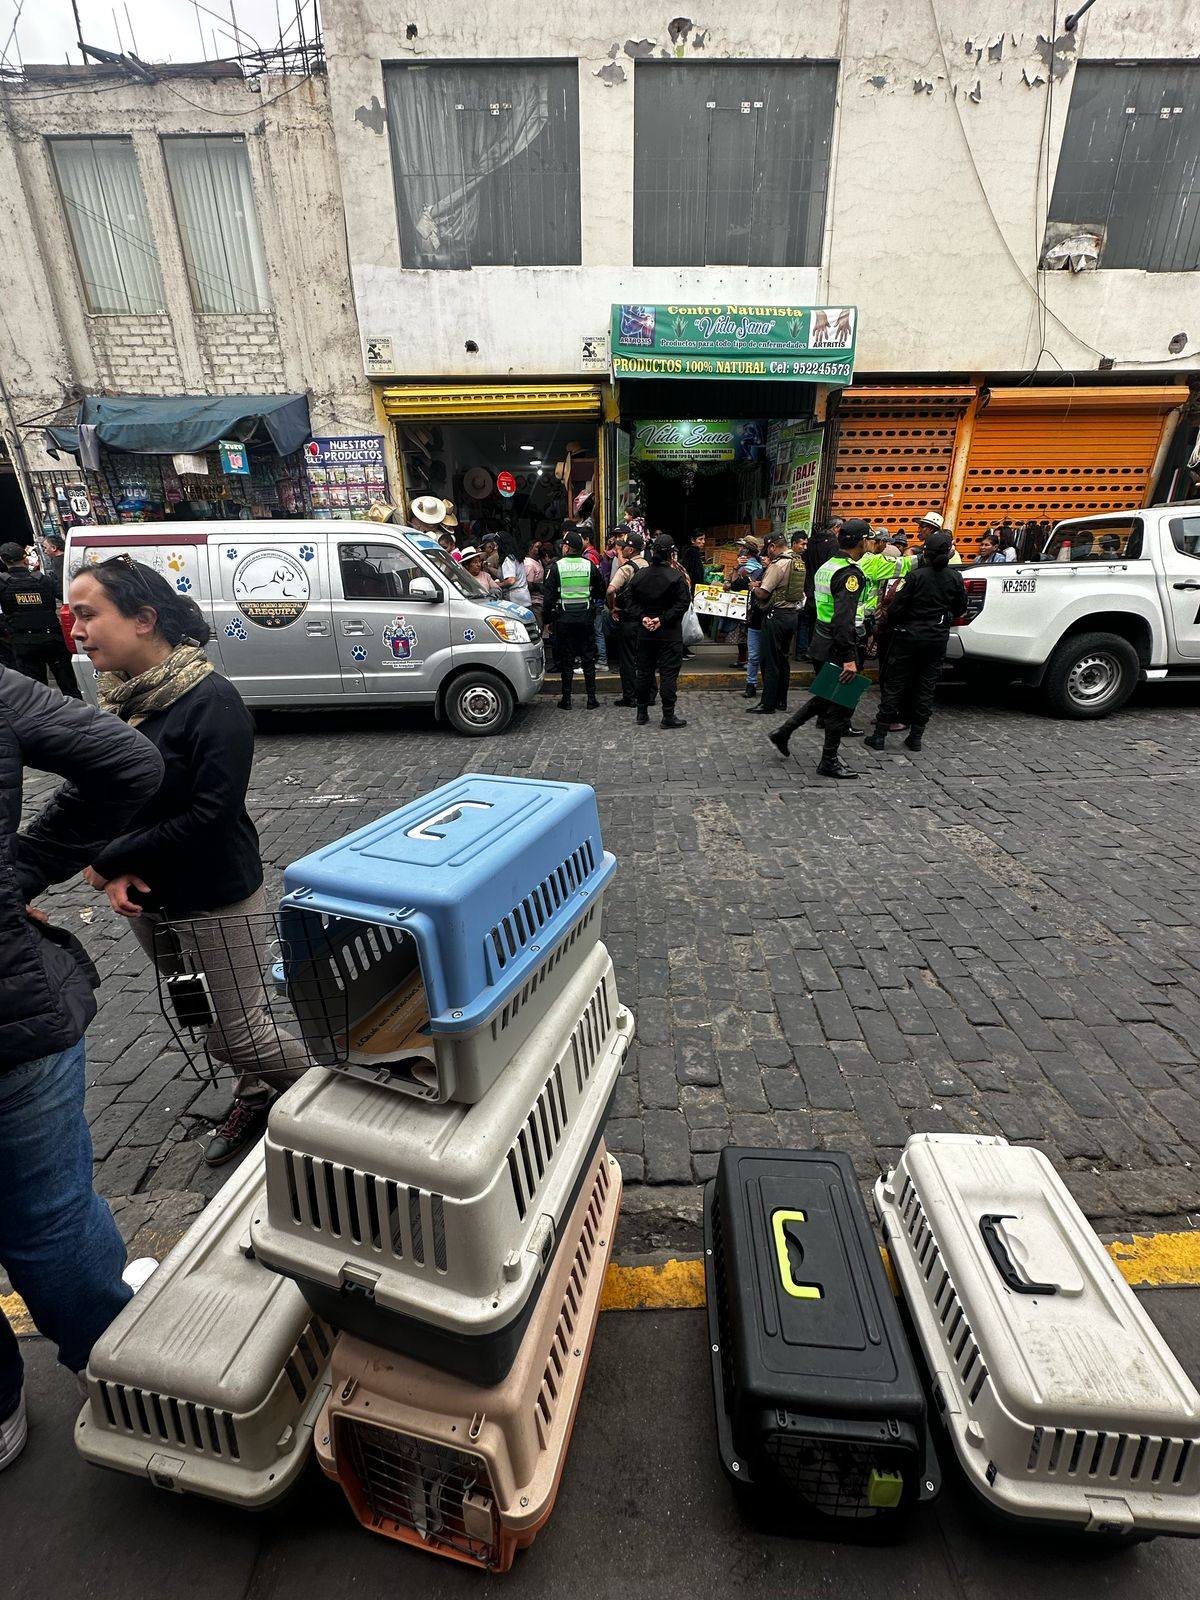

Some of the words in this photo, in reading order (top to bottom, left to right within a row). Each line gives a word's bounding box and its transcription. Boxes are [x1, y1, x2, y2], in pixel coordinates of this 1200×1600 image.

[667, 305, 722, 315] Centro
[726, 305, 803, 317] Naturista
[619, 337, 652, 345] ARTROSIS
[660, 339, 696, 347] Productos
[697, 340, 715, 349] para
[733, 340, 748, 350] tipo
[758, 341, 807, 349] enfermedades
[613, 358, 682, 373] PRODUCTOS
[685, 361, 713, 373] 100%
[716, 361, 766, 374] NATURAL
[769, 361, 790, 374] Cel:
[792, 362, 850, 376] 952245573
[637, 423, 683, 447] Vida
[682, 424, 734, 448] Sana
[329, 440, 380, 450] NUESTROS
[324, 450, 383, 462] PRODUCTOS
[1003, 580, 1036, 592] KP-25619
[17, 594, 41, 603] POLICIA
[248, 608, 298, 617] AREQUIPA
